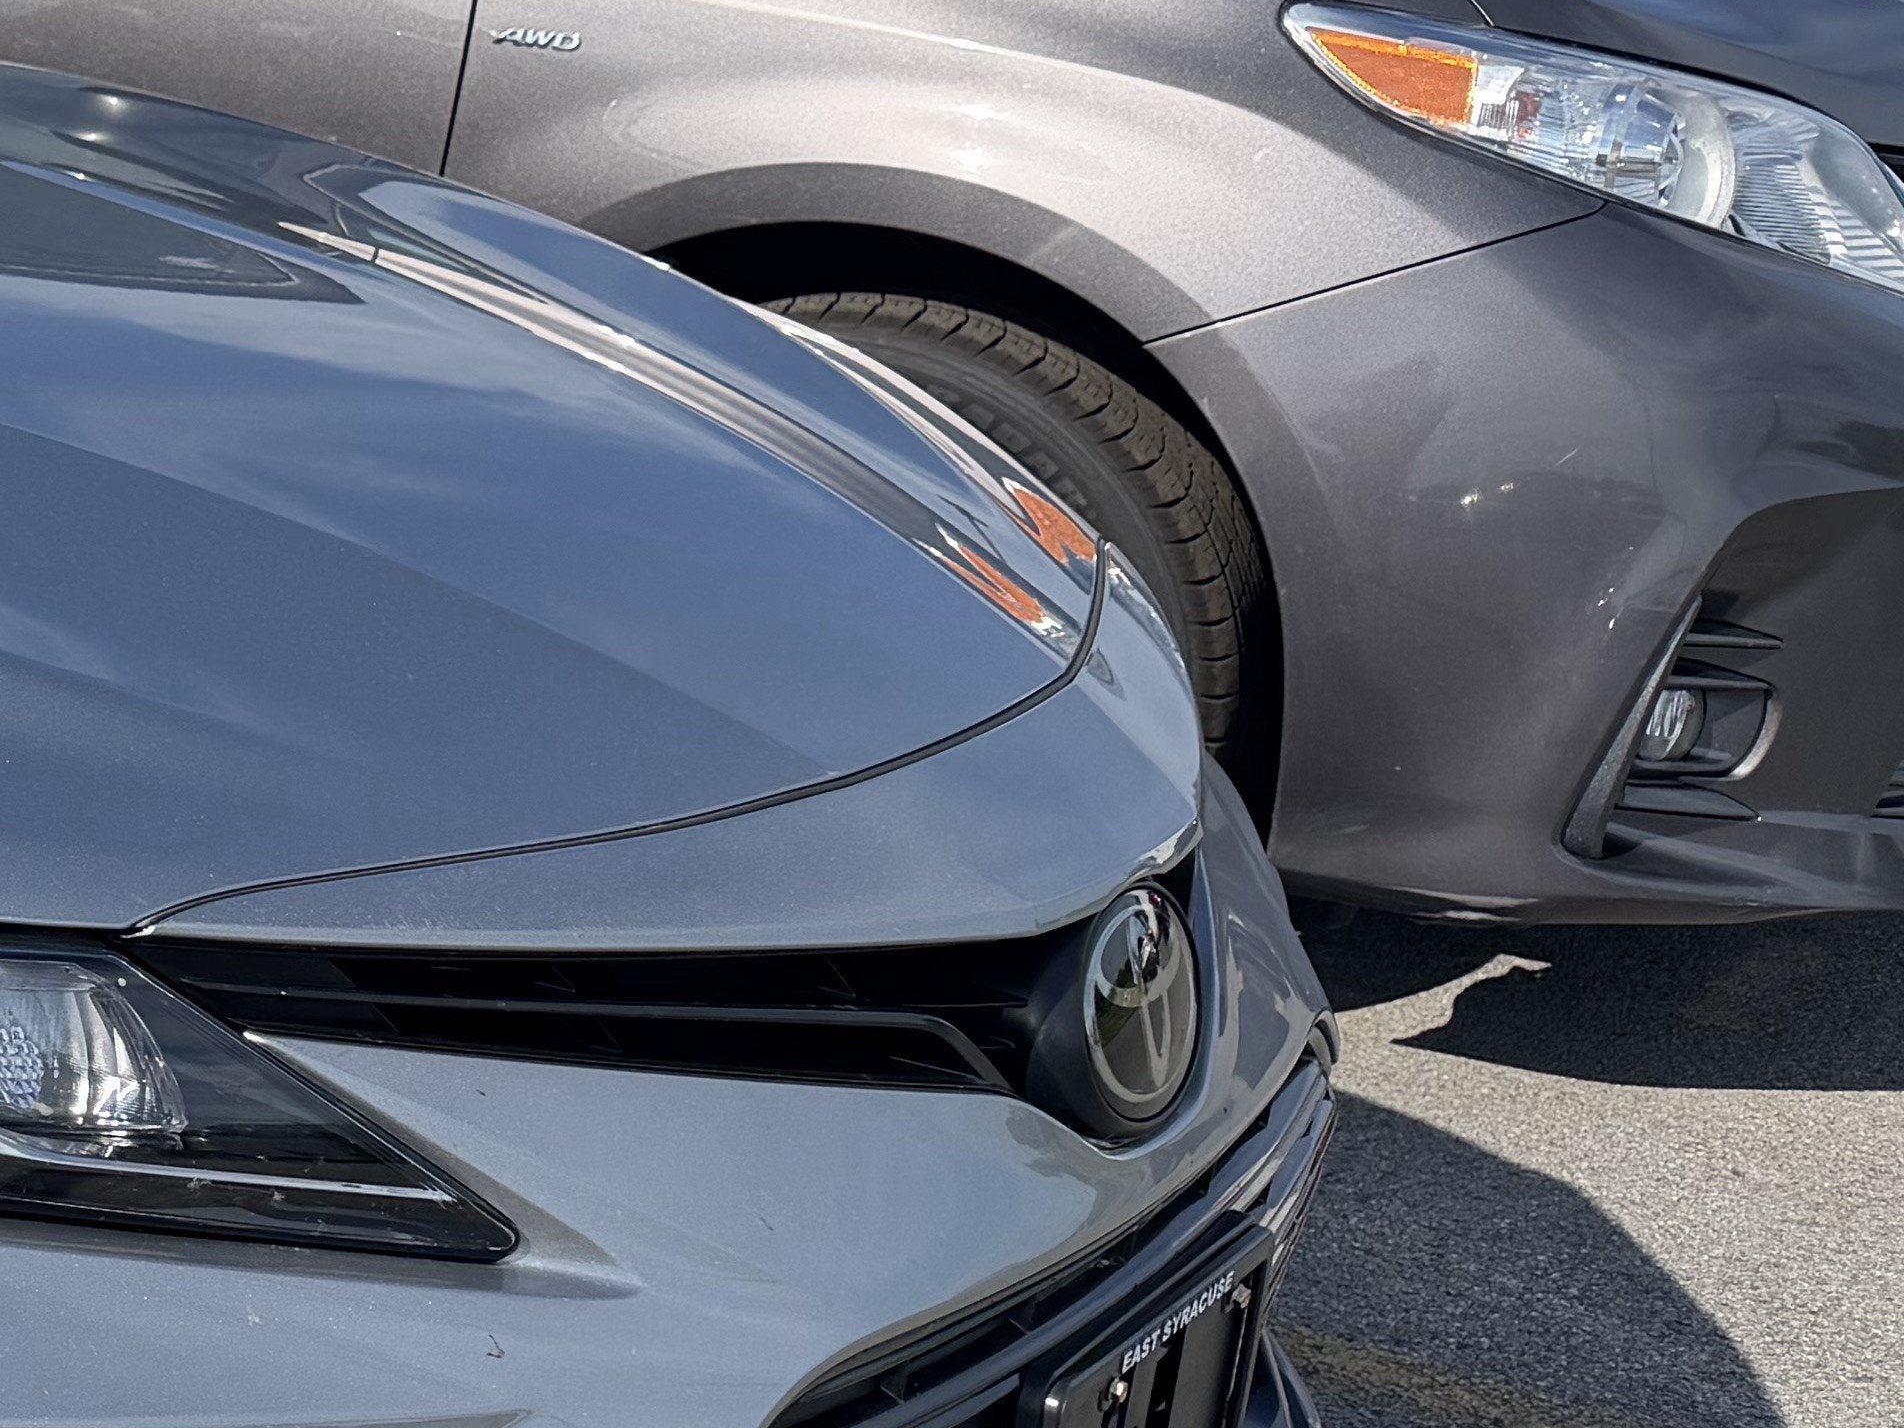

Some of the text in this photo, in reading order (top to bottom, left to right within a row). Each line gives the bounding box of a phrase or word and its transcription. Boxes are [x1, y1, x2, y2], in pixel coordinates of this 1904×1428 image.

[492, 27, 583, 52] AWD
[1121, 1271, 1235, 1374] EAST SYRACUSE
